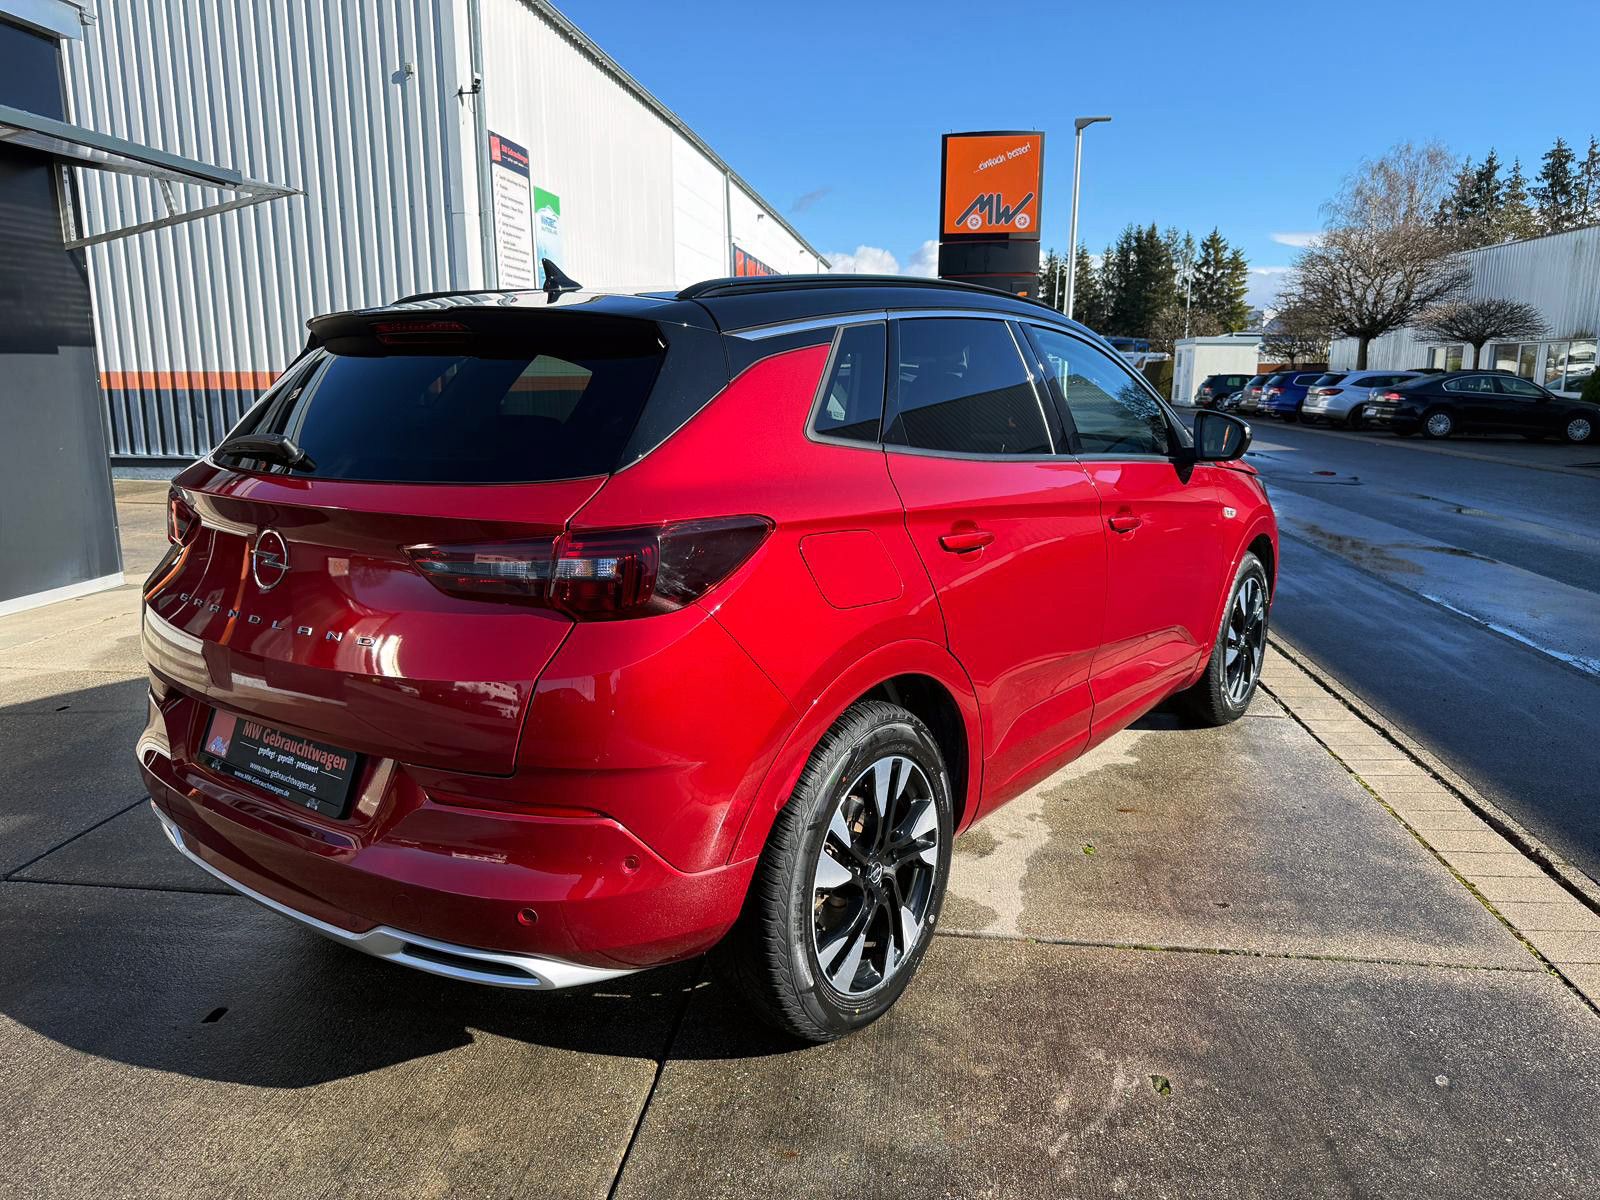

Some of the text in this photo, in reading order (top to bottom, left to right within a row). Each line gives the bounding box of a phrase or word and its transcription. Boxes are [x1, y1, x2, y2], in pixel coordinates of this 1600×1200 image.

[1007, 142, 1032, 159] besser!
[955, 192, 1034, 228] MW
[180, 593, 377, 647] GRANDLAND
[243, 720, 263, 740] MW
[262, 729, 348, 771] Gebrauchtwagen
[249, 761, 317, 793] www.mw-gebrauchtwagen.de
[295, 759, 319, 774] preiswert
